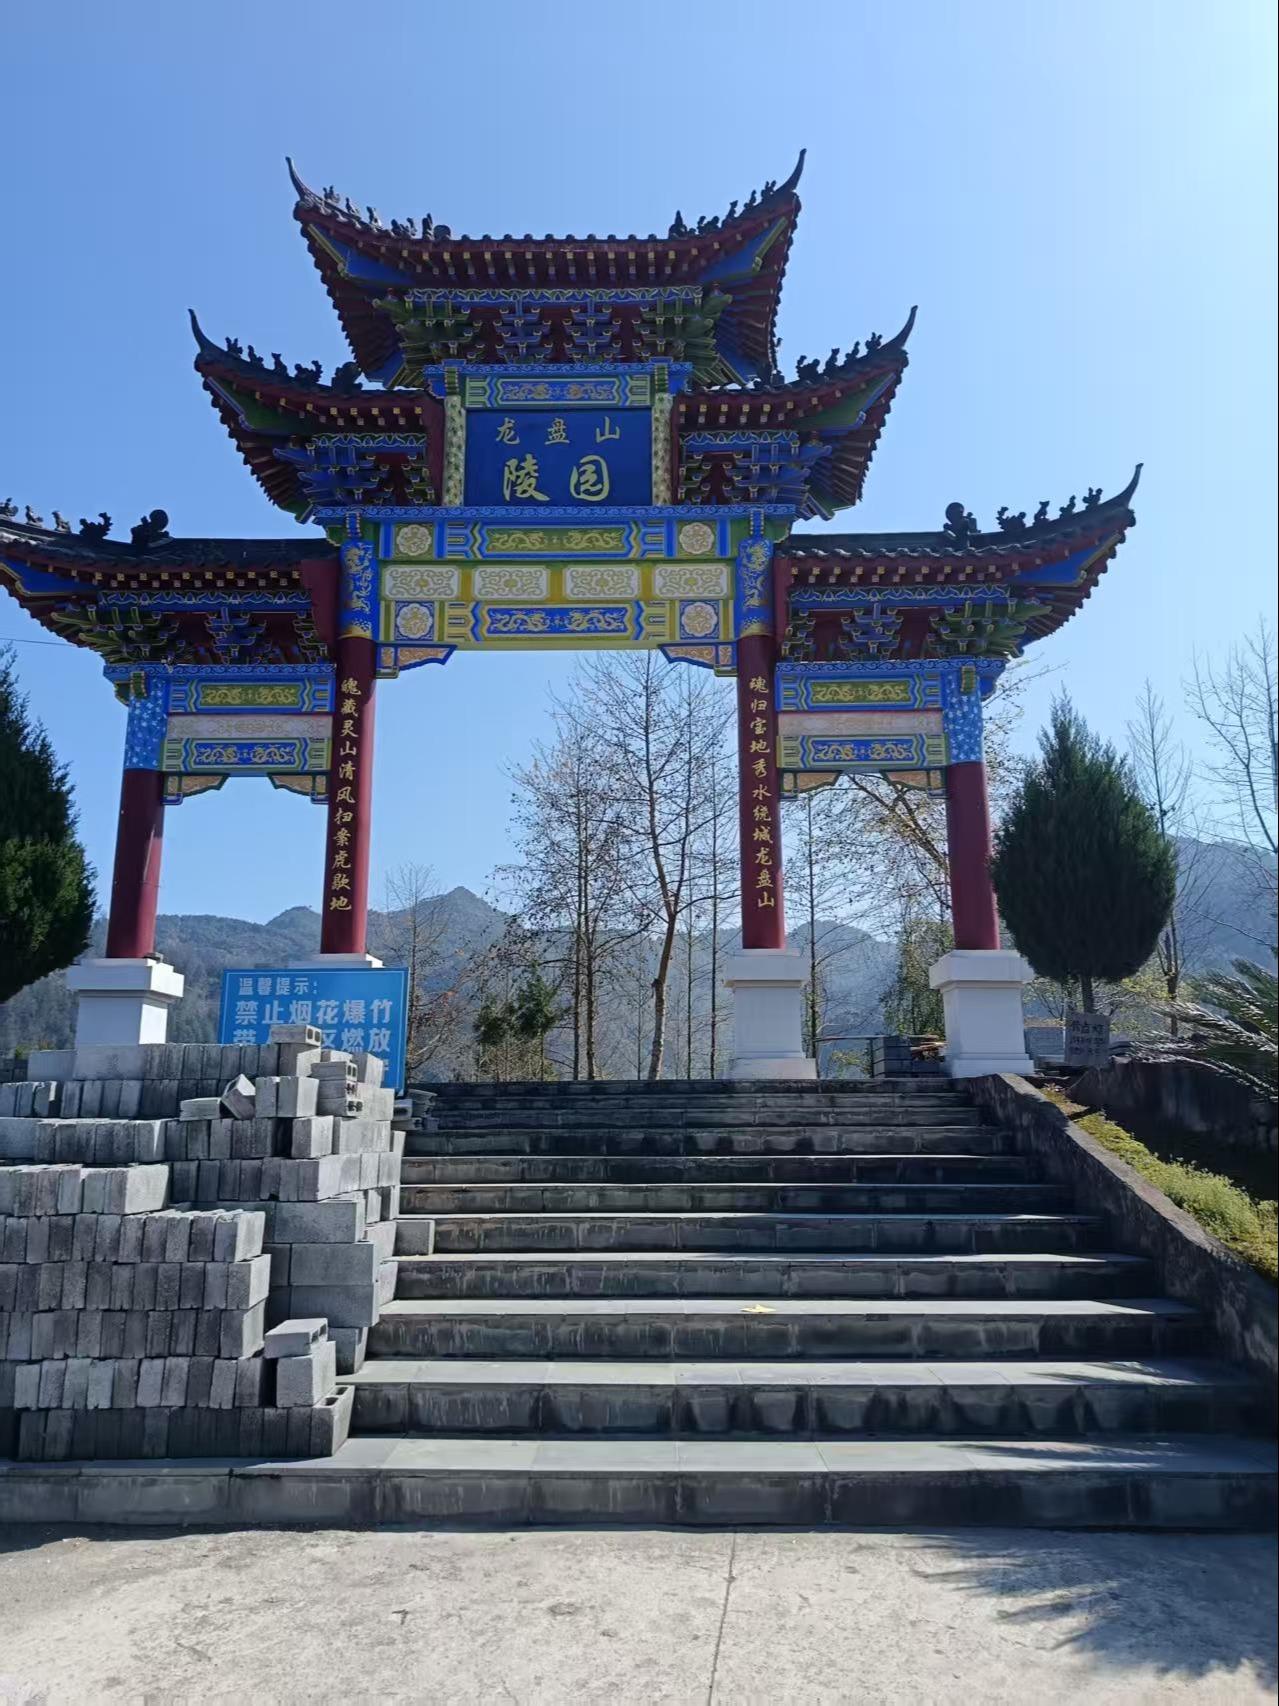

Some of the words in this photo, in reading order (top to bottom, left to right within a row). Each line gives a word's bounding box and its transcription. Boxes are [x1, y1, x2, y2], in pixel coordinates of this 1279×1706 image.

[495, 415, 621, 446] 龙盘山
[502, 453, 610, 502] 陵园
[234, 998, 394, 1026] 禁止烟花爆竹
[232, 1027, 391, 1052] 带区燃放
